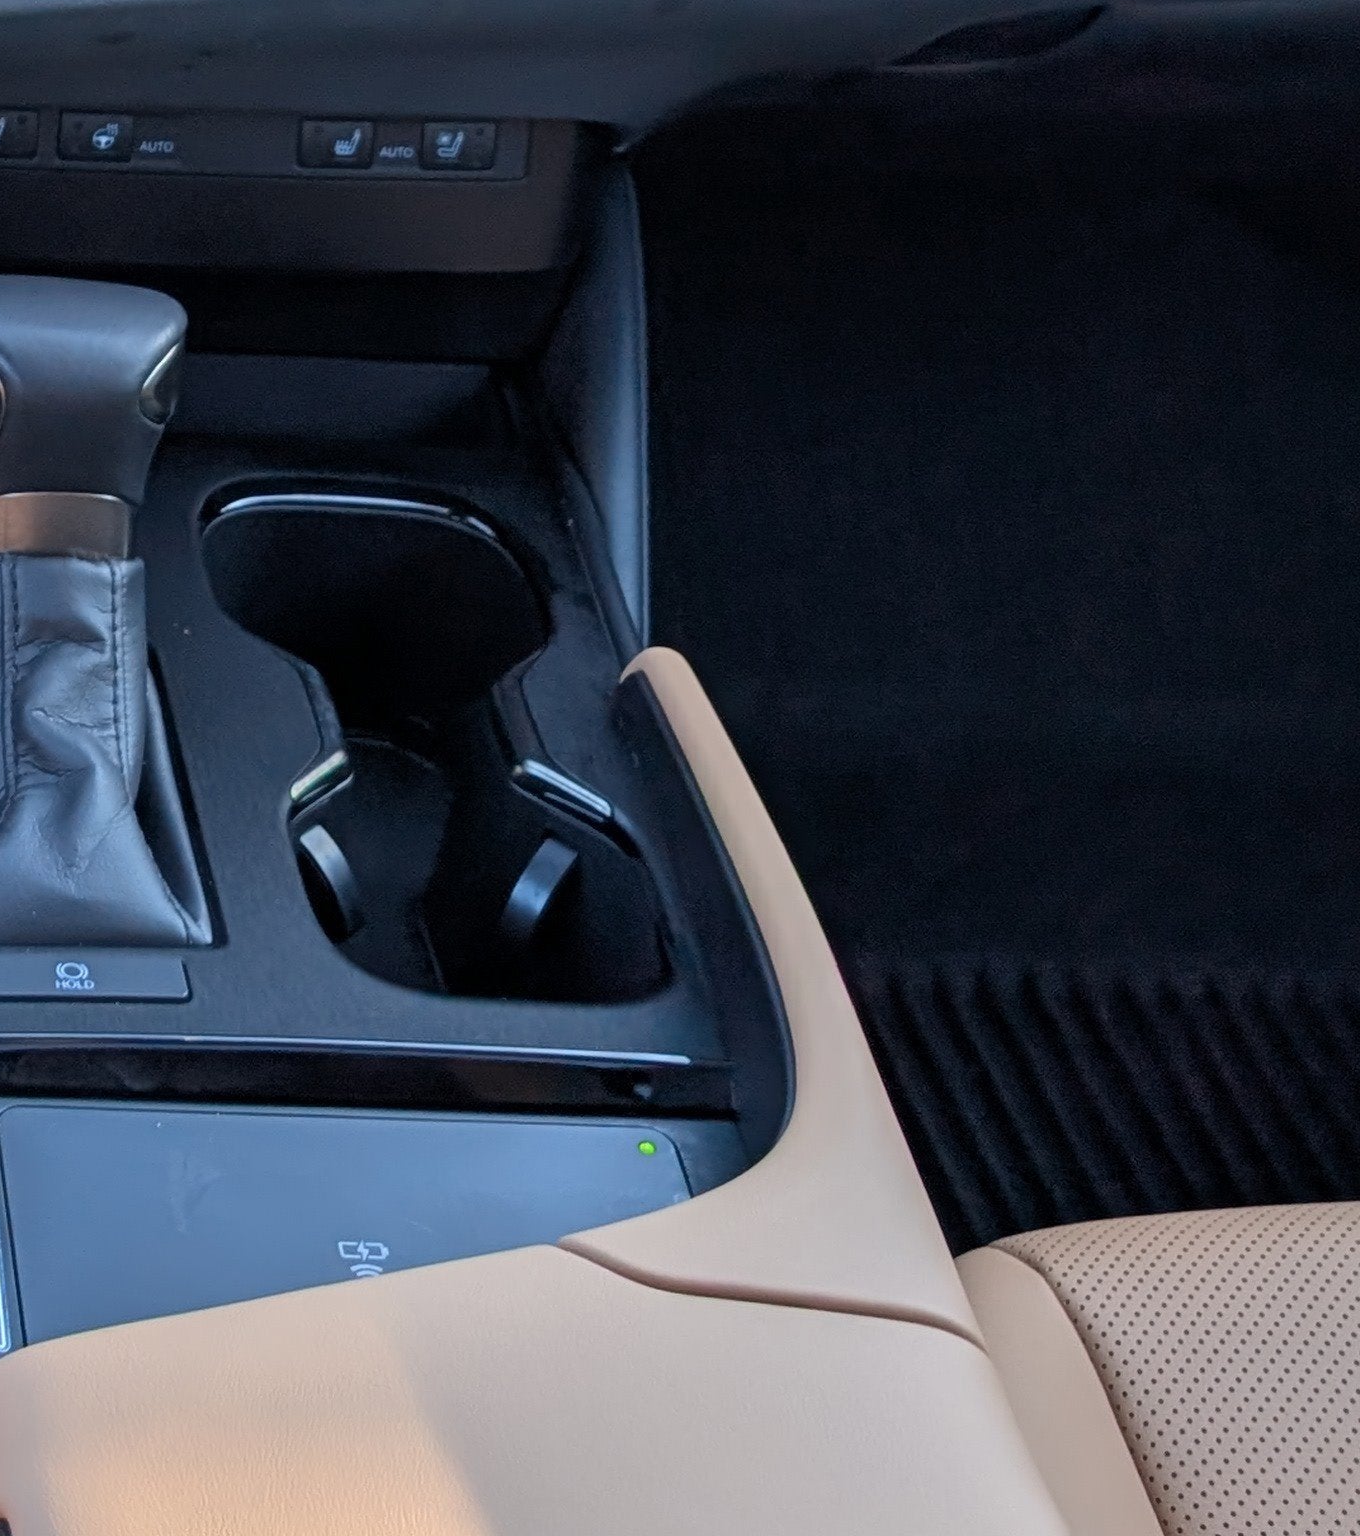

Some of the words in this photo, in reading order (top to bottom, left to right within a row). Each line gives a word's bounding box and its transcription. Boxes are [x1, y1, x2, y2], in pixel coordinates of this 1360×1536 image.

[139, 140, 175, 154] AUTO
[379, 145, 415, 159] AUTO
[54, 978, 95, 991] HOLD
